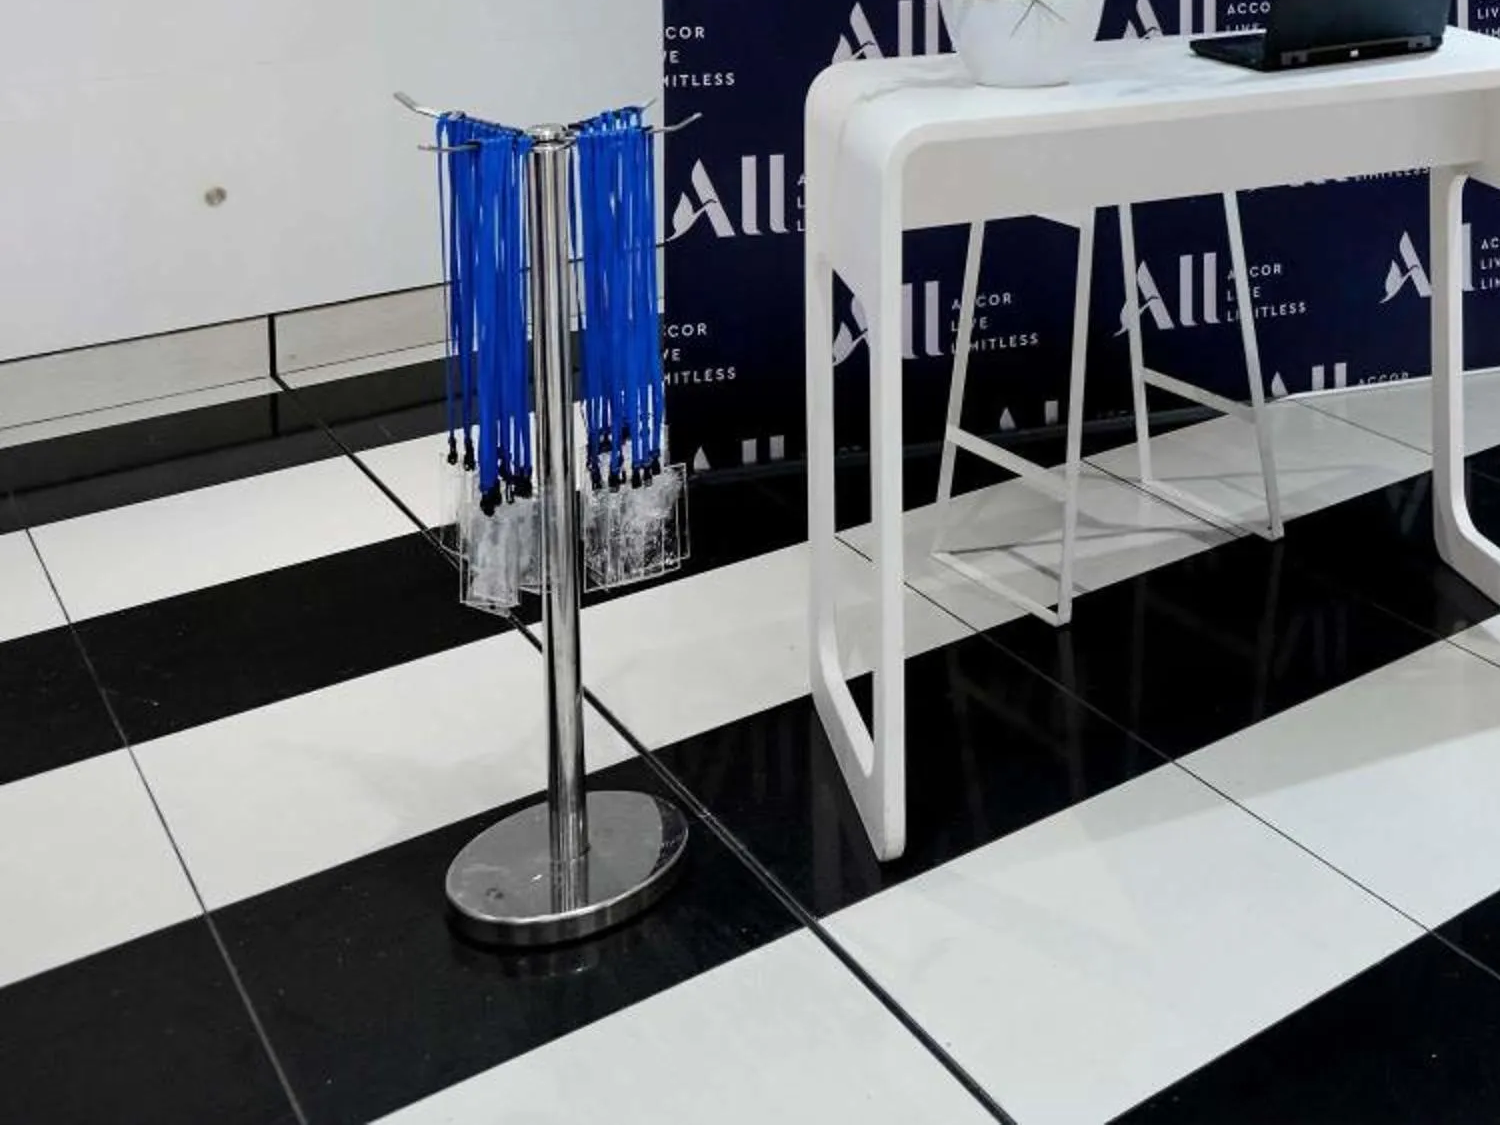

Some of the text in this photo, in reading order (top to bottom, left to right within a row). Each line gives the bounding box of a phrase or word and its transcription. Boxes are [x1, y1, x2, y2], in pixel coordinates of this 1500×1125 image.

[1227, 0, 1271, 15] ACCO
[1227, 263, 1282, 281] ACOR
[951, 292, 1012, 310] ACOR
[1227, 302, 1306, 322] LIITLESS
